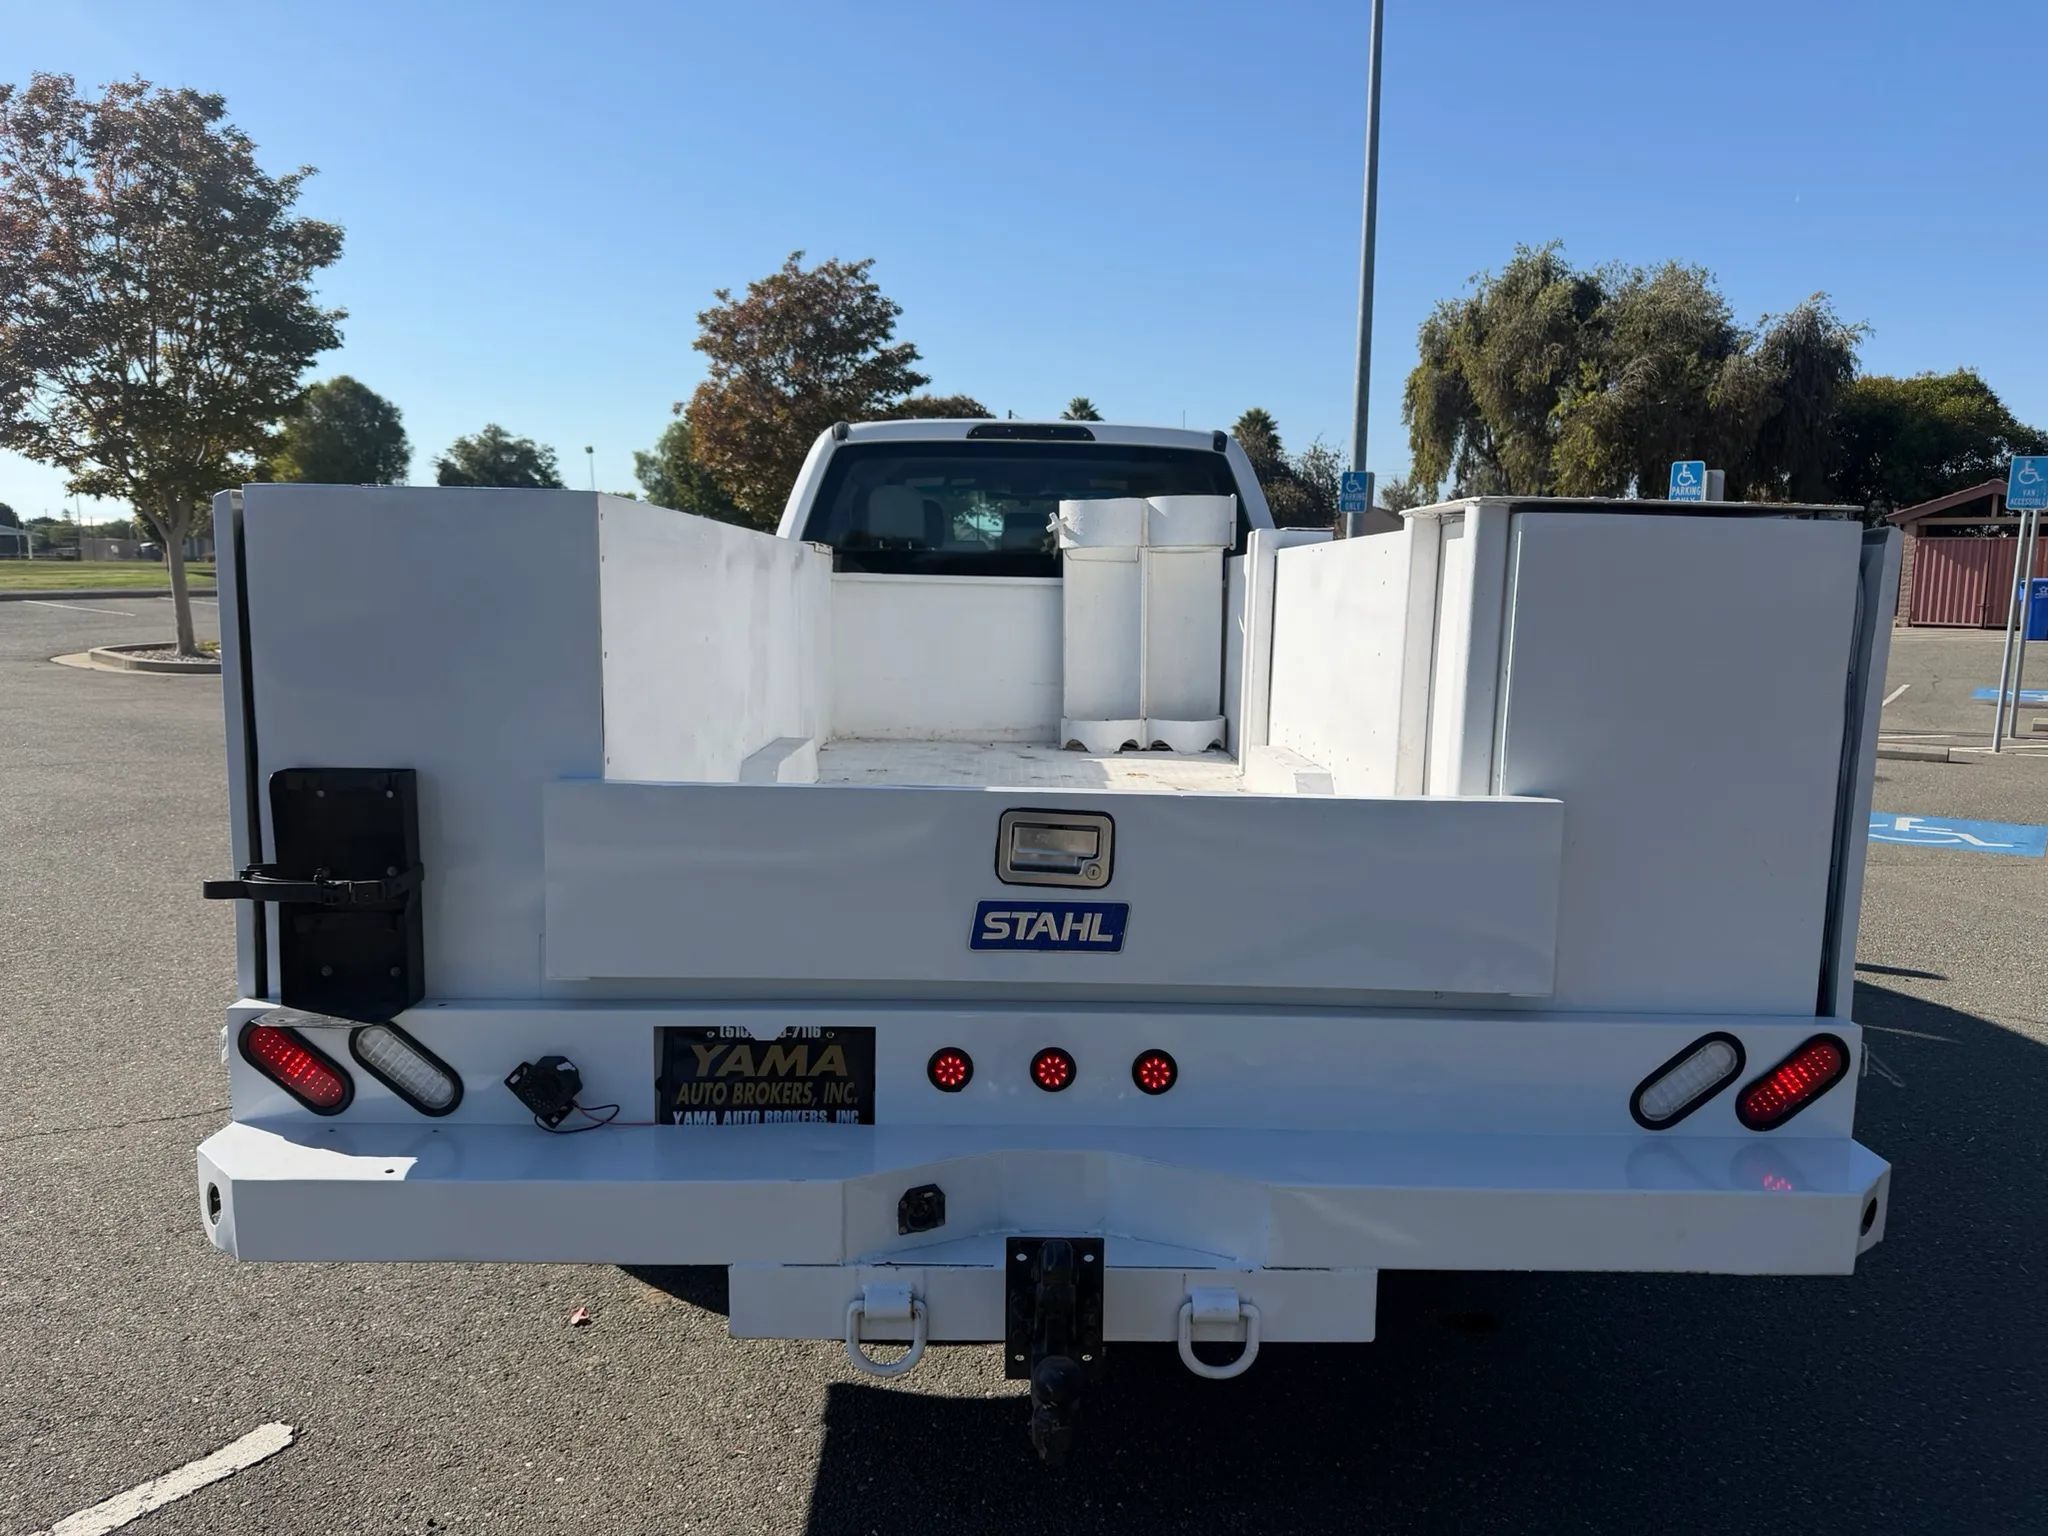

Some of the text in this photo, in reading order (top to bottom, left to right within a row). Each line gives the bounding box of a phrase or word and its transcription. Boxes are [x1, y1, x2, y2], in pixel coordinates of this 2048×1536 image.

[1671, 486, 1701, 496] PARKING
[982, 911, 1113, 943] STAHL
[690, 1044, 848, 1077] YAMA
[676, 1082, 859, 1107] AUTO BROKERS, INC.
[672, 1110, 717, 1126] YAMA
[722, 1110, 760, 1125] AUTO
